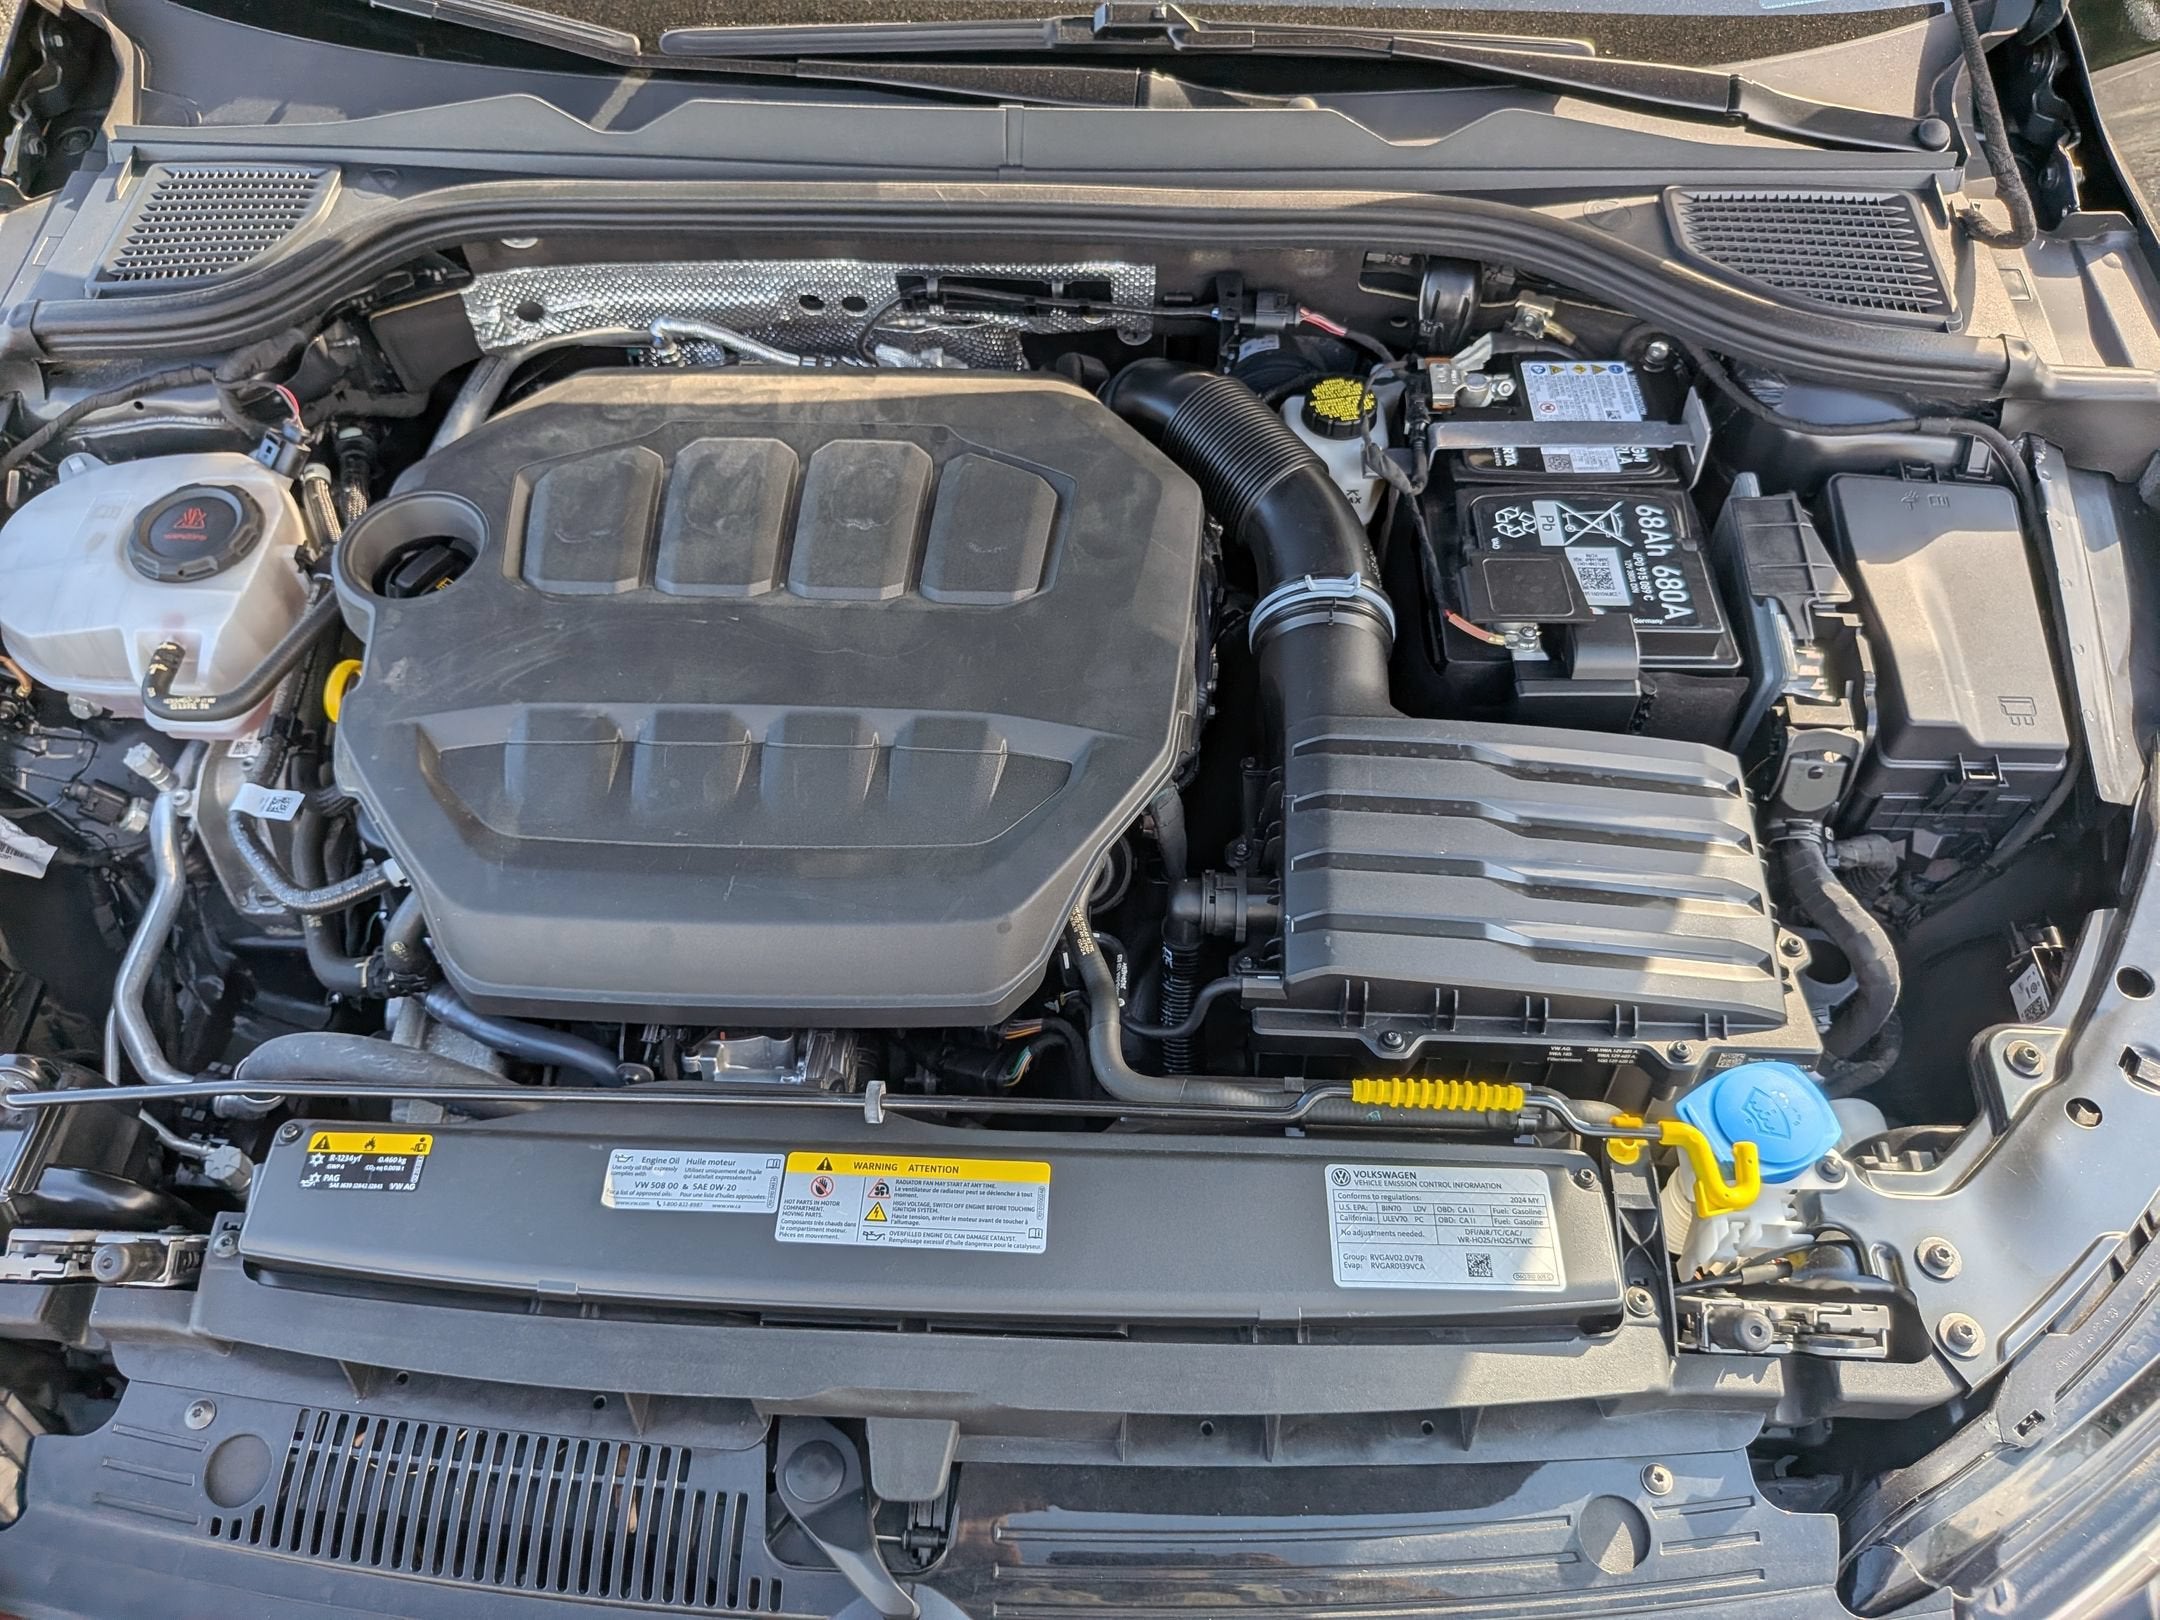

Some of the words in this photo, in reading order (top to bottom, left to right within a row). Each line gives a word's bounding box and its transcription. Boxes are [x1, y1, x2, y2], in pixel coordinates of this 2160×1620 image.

[1502, 447, 1518, 467] RTA
[1630, 447, 1649, 463] GM
[1540, 515, 1556, 531] Pb
[1635, 504, 1675, 557] 68Ah
[1651, 565, 1695, 620] 680A
[1643, 594, 1655, 602] C
[328, 1154, 363, 1164] R-1234yf
[398, 1157, 407, 1165] kg
[641, 1156, 667, 1166] Engine
[668, 1157, 680, 1165] Oil
[686, 1158, 707, 1166] Huile
[707, 1158, 737, 1166] moteur
[853, 1161, 898, 1171] WARNING
[908, 1163, 960, 1174] ATTENTION
[322, 1174, 341, 1182] PAG
[1352, 1169, 1417, 1180] VOLKSWAGEN
[403, 1183, 416, 1191] AG
[634, 1181, 650, 1189] VW
[650, 1181, 666, 1189] 508
[667, 1182, 679, 1190] 00
[692, 1183, 708, 1191] SAE
[1353, 1179, 1382, 1187] VEHICLE
[1384, 1180, 1418, 1188] EMISSION
[1418, 1181, 1451, 1189] CONTROL
[1452, 1182, 1502, 1190] INFORMATION
[1337, 1192, 1371, 1200] Conforms
[1380, 1193, 1421, 1202] regulations:
[1509, 1196, 1527, 1204] 2024
[1007, 1205, 1035, 1213] TOUCHING
[1413, 1205, 1427, 1213] LDV
[1436, 1206, 1455, 1214] OBD:
[1492, 1207, 1510, 1215] Fuel:
[1512, 1207, 1542, 1216] Gasoline
[1339, 1214, 1376, 1222] California:
[1382, 1215, 1408, 1223] ULEV70
[1414, 1215, 1424, 1223] PC
[1438, 1216, 1456, 1224] OBD:
[1513, 1218, 1544, 1226] Gasoline
[889, 1230, 922, 1238] OVERFILLED
[1353, 1229, 1396, 1238] adjustments
[1397, 1230, 1425, 1238] needed.
[888, 1236, 922, 1245] Remplissage
[964, 1240, 993, 1248] dangereux
[1342, 1253, 1368, 1262] Group:
[1343, 1262, 1363, 1270] Evap:
